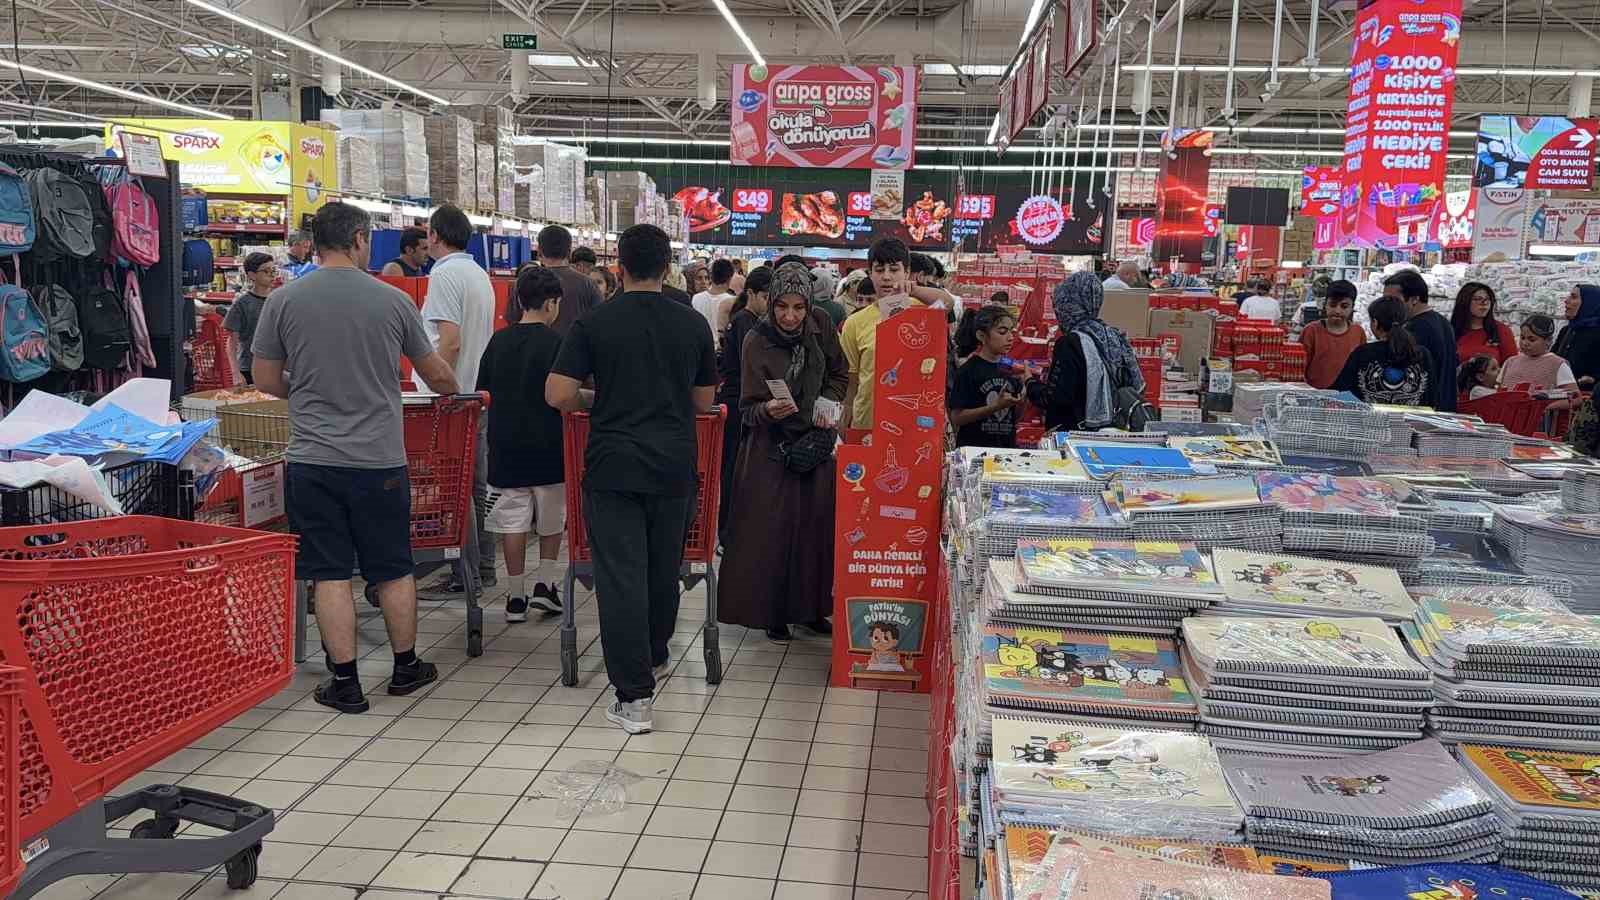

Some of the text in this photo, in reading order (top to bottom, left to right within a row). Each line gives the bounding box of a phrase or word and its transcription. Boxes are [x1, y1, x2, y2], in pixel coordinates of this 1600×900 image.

[1384, 71, 1443, 90] KİŞİYE
[775, 84, 872, 106] anpa gross
[1376, 90, 1445, 106] KIRTASİYE
[769, 111, 813, 130] okula
[1373, 119, 1412, 131] 1.000
[173, 135, 220, 150] SPARX
[783, 124, 870, 146] dönüyoruz!
[1372, 132, 1443, 151] HEDİYE
[301, 140, 325, 156] SPARX
[1381, 152, 1432, 169] ÇEKİ!
[737, 191, 769, 208] 349
[1490, 190, 1518, 198] FATİH
[853, 549, 922, 561] DAHA RENKLİ
[848, 562, 927, 577] BİR DÜNYA İÇİN
[870, 576, 904, 589] FATİH!
[863, 611, 912, 626] DÜNYASI
